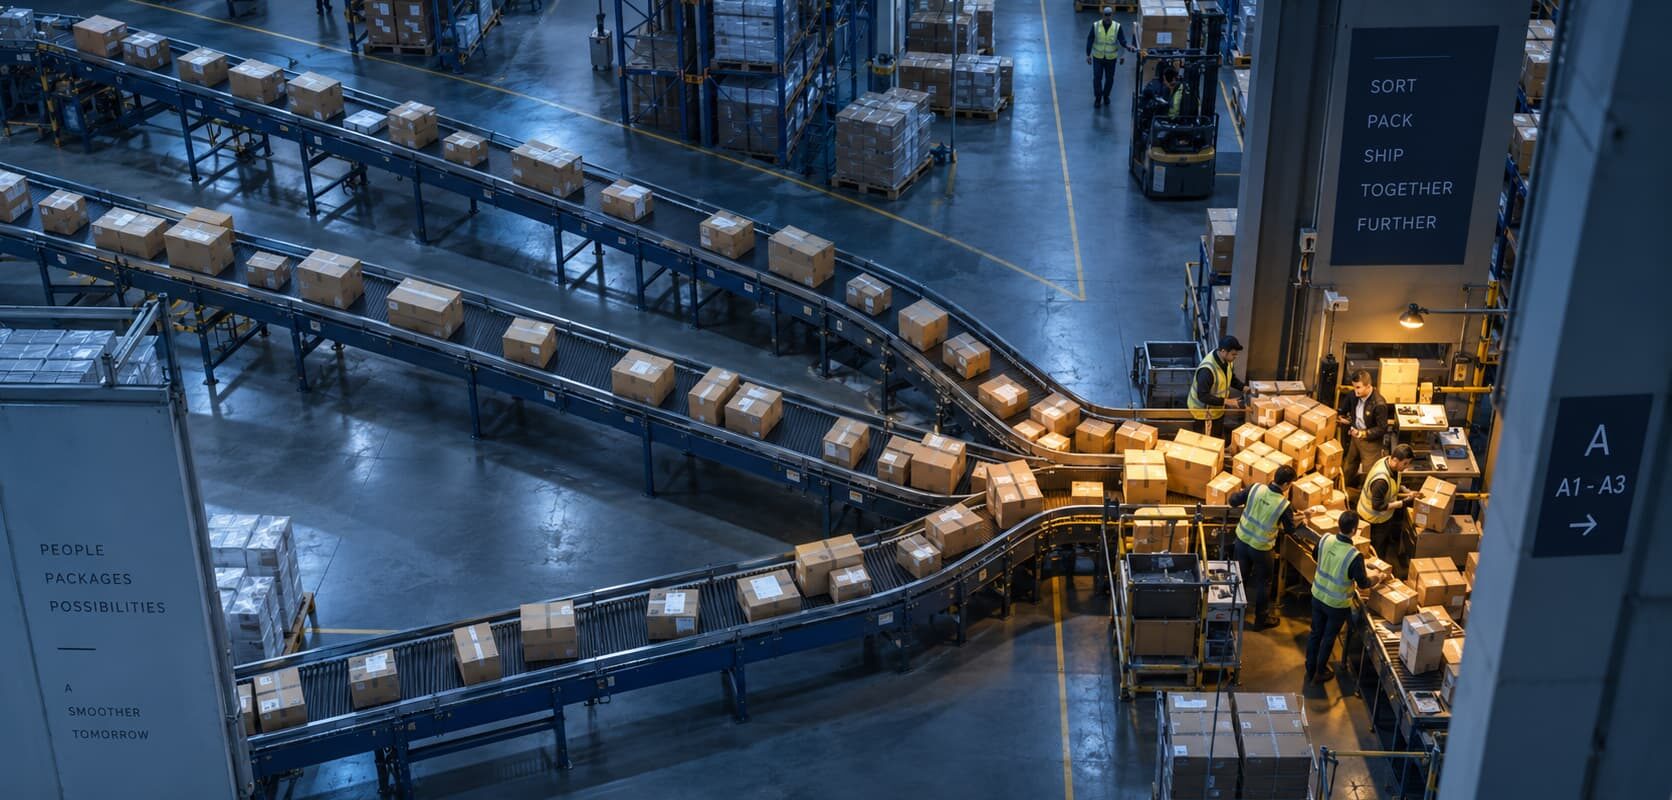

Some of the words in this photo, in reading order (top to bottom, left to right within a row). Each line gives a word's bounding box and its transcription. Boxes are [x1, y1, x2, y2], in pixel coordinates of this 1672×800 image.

[1371, 79, 1416, 93] SORT
[1368, 113, 1413, 128] PACK
[1364, 148, 1404, 163] SHIP
[1361, 181, 1453, 197] TOGETHER
[1357, 216, 1437, 231] FURTHER
[1584, 424, 1609, 456] A
[1555, 477, 1581, 497] A1
[1598, 475, 1626, 495] A3
[40, 543, 105, 556] PEOPLE
[45, 572, 132, 585] PACKAGES
[50, 600, 166, 614] POSSIBILITIES
[64, 683, 73, 693] A
[68, 706, 141, 718] SMOOTHER
[72, 729, 149, 740] TOMORROW
